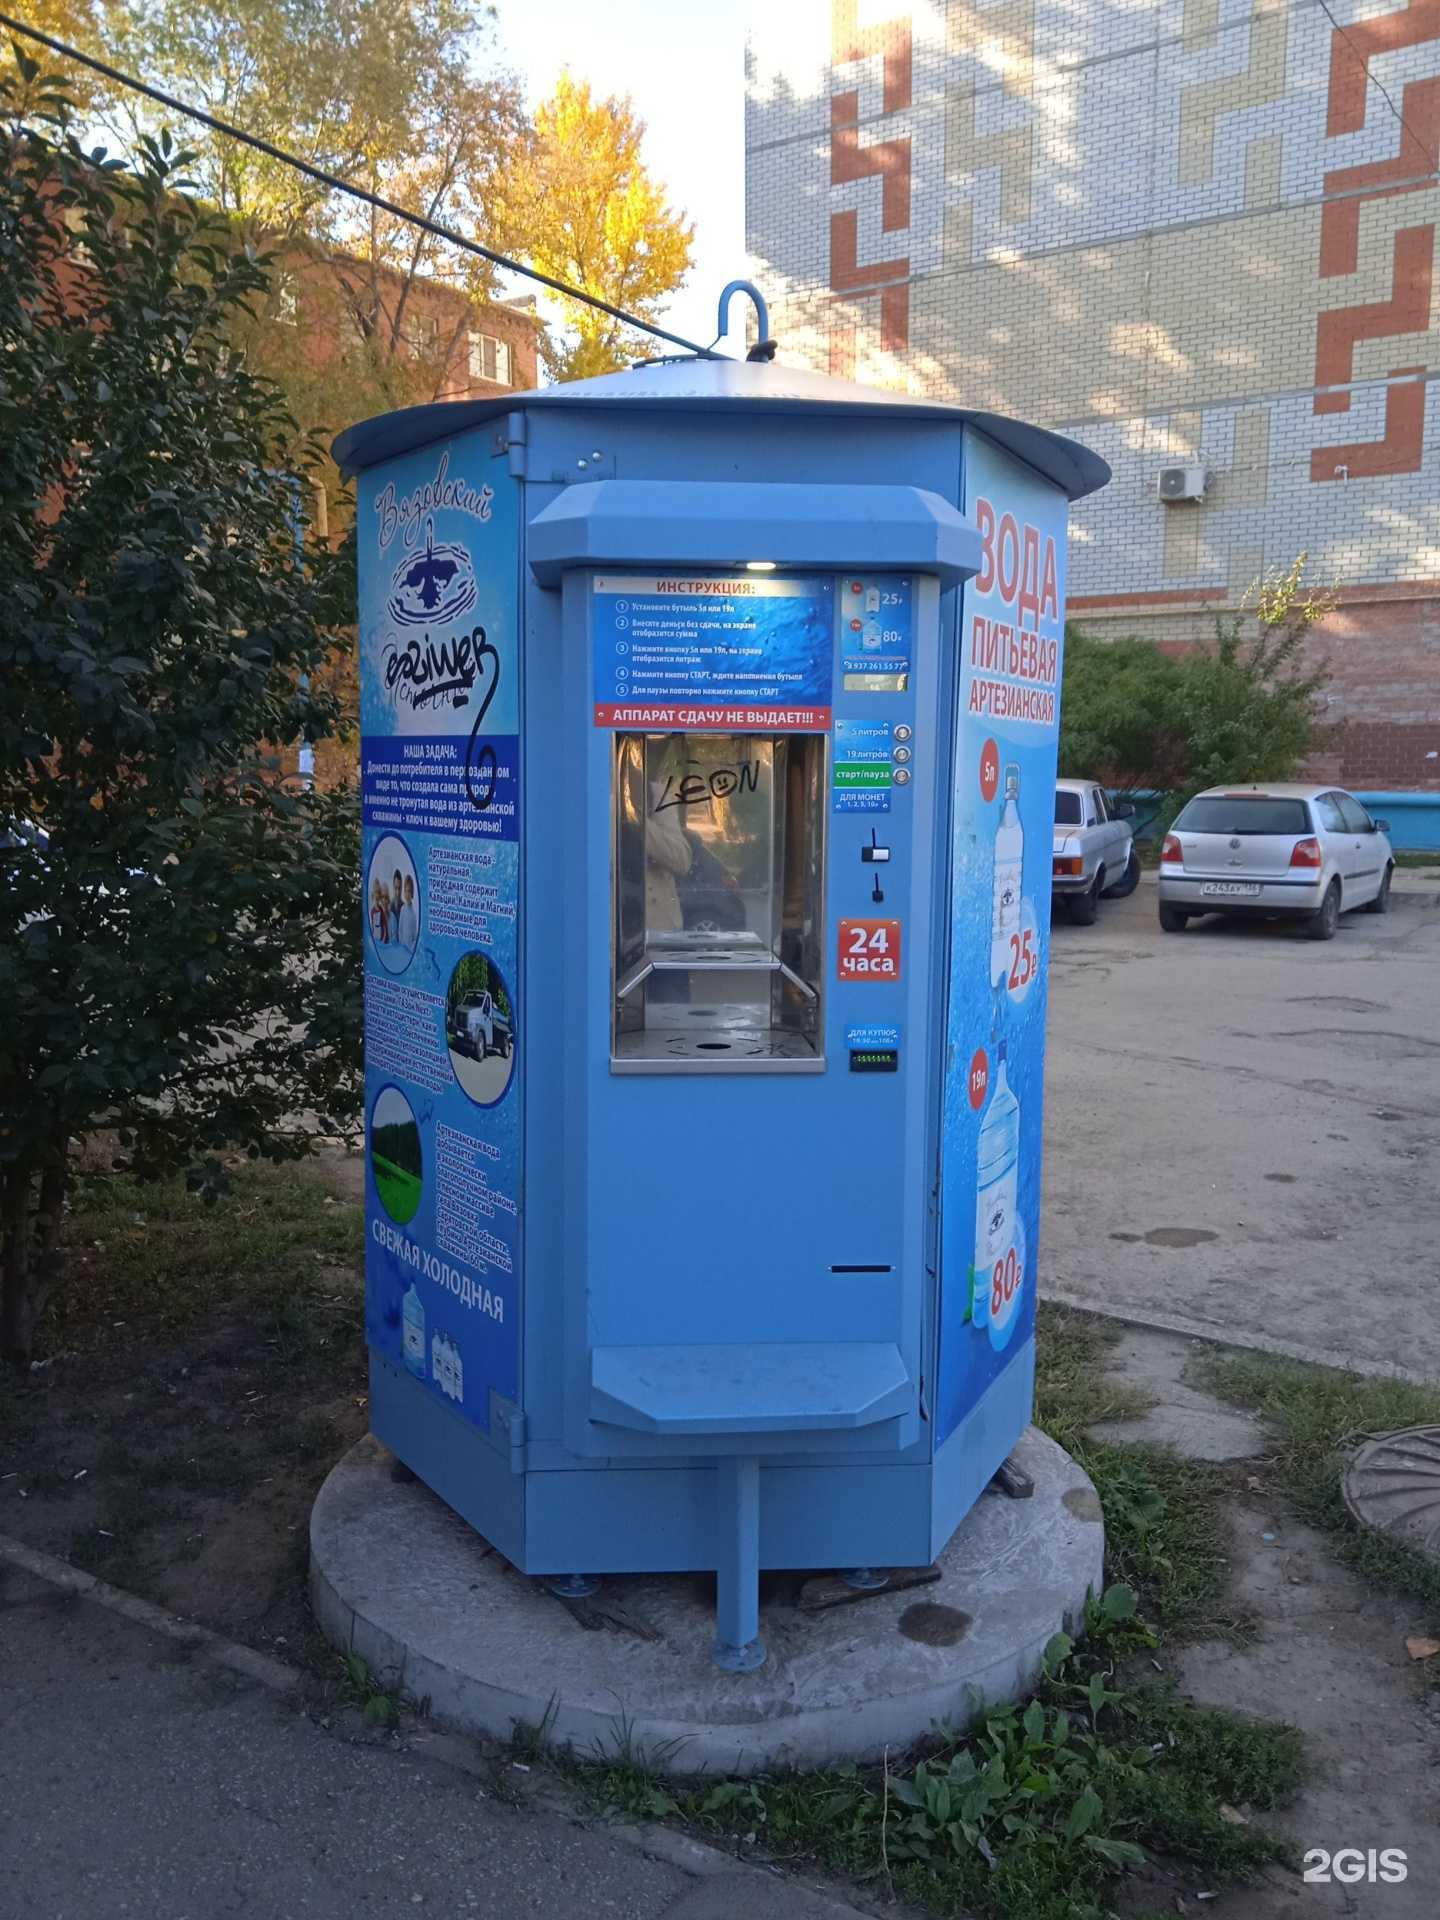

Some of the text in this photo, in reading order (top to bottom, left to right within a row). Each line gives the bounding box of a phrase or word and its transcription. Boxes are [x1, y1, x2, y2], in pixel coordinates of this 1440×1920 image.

[656, 581, 756, 596] ИНСТРУКЦИЯ:
[632, 602, 671, 612] Установите
[672, 603, 698, 613] бутыль
[708, 605, 720, 613] или
[632, 620, 660, 629] Внесите
[660, 621, 685, 630] деньги
[686, 620, 698, 629] без
[632, 630, 675, 639] отобразится
[632, 644, 664, 654] Нажмите
[665, 646, 689, 654] кнопку
[971, 616, 1057, 683] ПИТЬЕВАЯ
[632, 655, 701, 665] отобразится литраж
[632, 670, 664, 679] Нажмите
[665, 672, 689, 680] кнопку
[712, 673, 734, 681] ждите
[735, 673, 777, 681] наполнения
[632, 686, 646, 695] Для
[648, 687, 669, 696] паузы
[670, 688, 701, 696] повторно
[703, 688, 733, 696] нажмите
[735, 689, 758, 697] кнопку
[760, 688, 779, 696] СТАРТ
[969, 679, 1054, 722] АРТЕЗИАНСКАЯ
[613, 709, 814, 725] АППАРАТ СДАЧУ НЕ ВЫДАЕТ!!!
[858, 729, 889, 738] литров
[404, 744, 457, 759] НАША ЗАДАЧА:
[847, 750, 888, 759] 19 литров
[367, 761, 510, 779] Донести до потребителя в перозданом
[836, 769, 890, 780] старт/пауза
[985, 762, 995, 782] 5л
[376, 779, 390, 790] виде
[390, 780, 399, 792] то,
[400, 781, 410, 791] что
[412, 782, 439, 794] создала
[440, 784, 458, 794] сама
[368, 796, 390, 806] именно
[391, 797, 399, 807] не
[399, 798, 429, 812] тронутая
[430, 800, 447, 813] вода
[448, 801, 457, 811] из
[840, 793, 885, 802] ДЛЯ МОНЕТ
[372, 810, 402, 822] скважины
[406, 815, 424, 826] ключ
[429, 818, 458, 832] вашему
[459, 818, 502, 834] здоровью!
[428, 846, 492, 866] Артезианская вода
[464, 882, 499, 898] содержит
[849, 927, 888, 954] 24
[843, 957, 894, 972] часа
[972, 1069, 986, 1092] 19л
[436, 1121, 500, 1160] Артезианская вода
[436, 1137, 475, 1162] добывается
[441, 1153, 486, 1183] экологически
[436, 1165, 488, 1197] благополучном
[373, 1219, 504, 1323] СВЕЖАЯ ХОЛОДНАЯ
